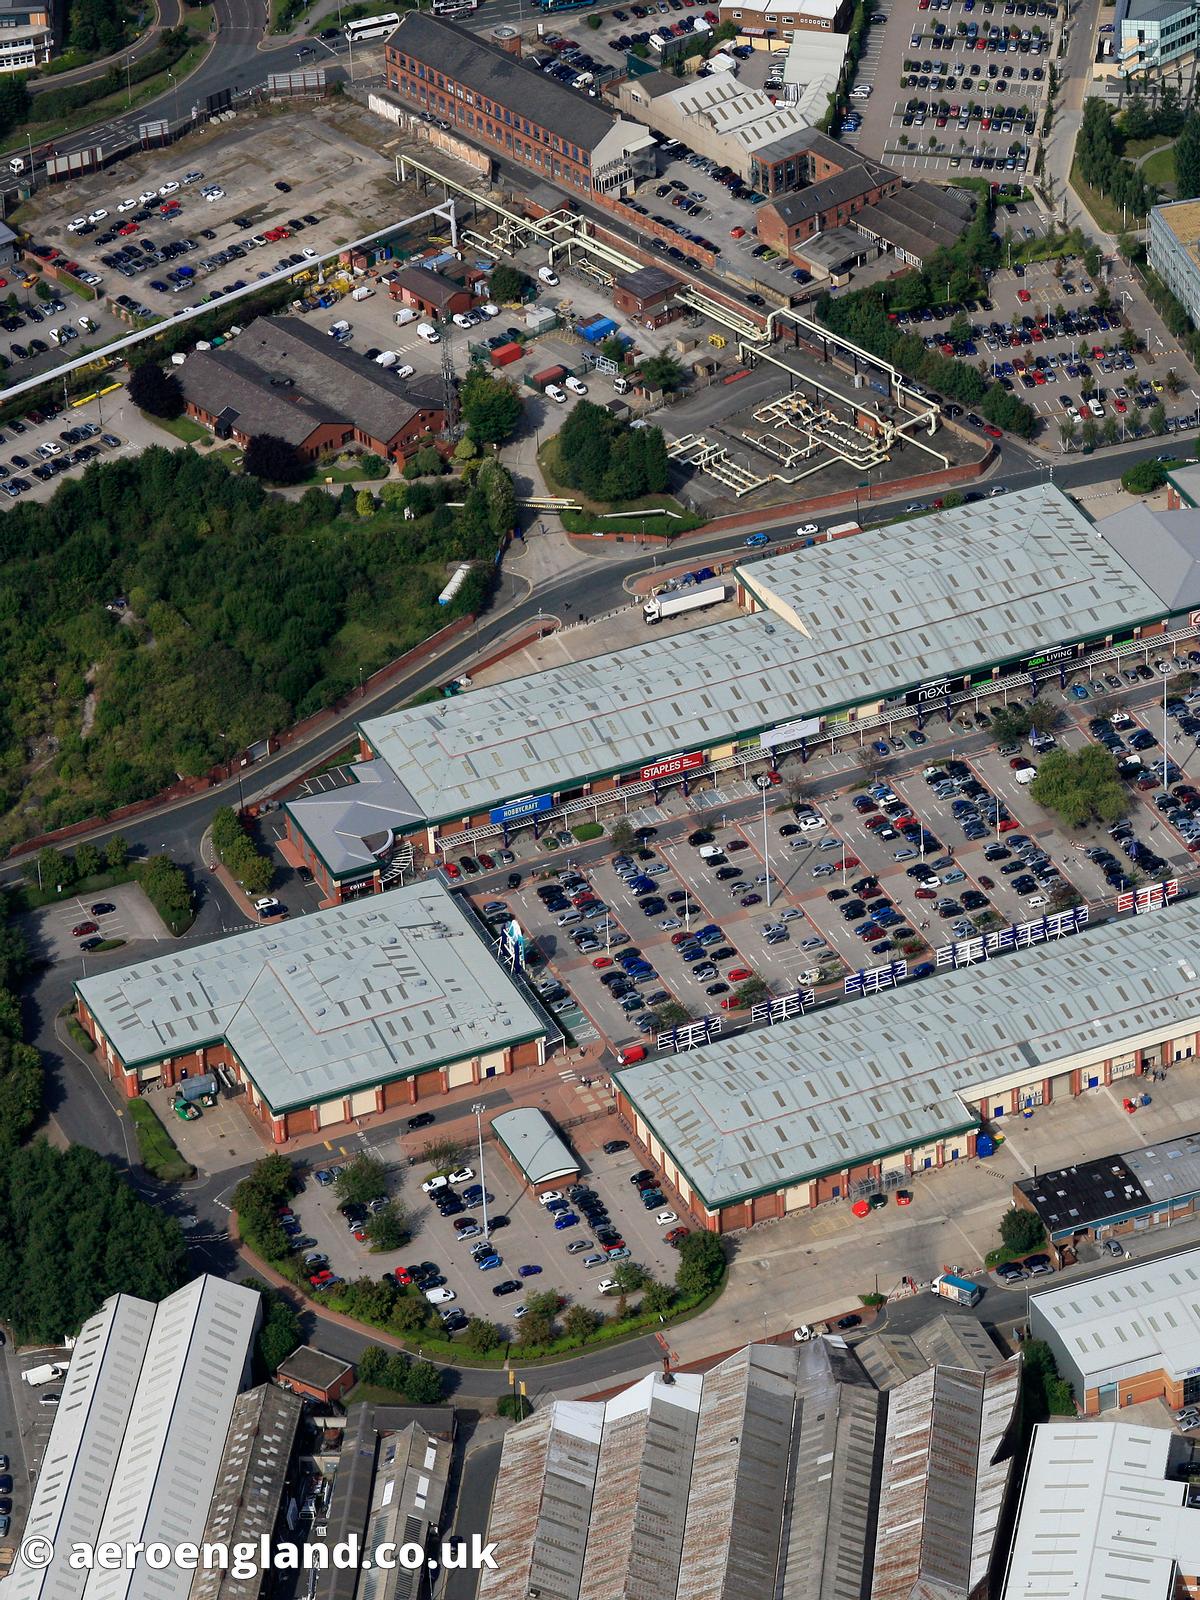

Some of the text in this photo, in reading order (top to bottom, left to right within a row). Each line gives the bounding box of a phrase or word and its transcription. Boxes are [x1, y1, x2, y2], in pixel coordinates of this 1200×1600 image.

[1028, 658, 1046, 668] ASDA
[1046, 649, 1072, 663] LIVING
[918, 683, 951, 701] next
[644, 760, 681, 778] STAPLES
[504, 802, 538, 817] HOBBYCRAFT
